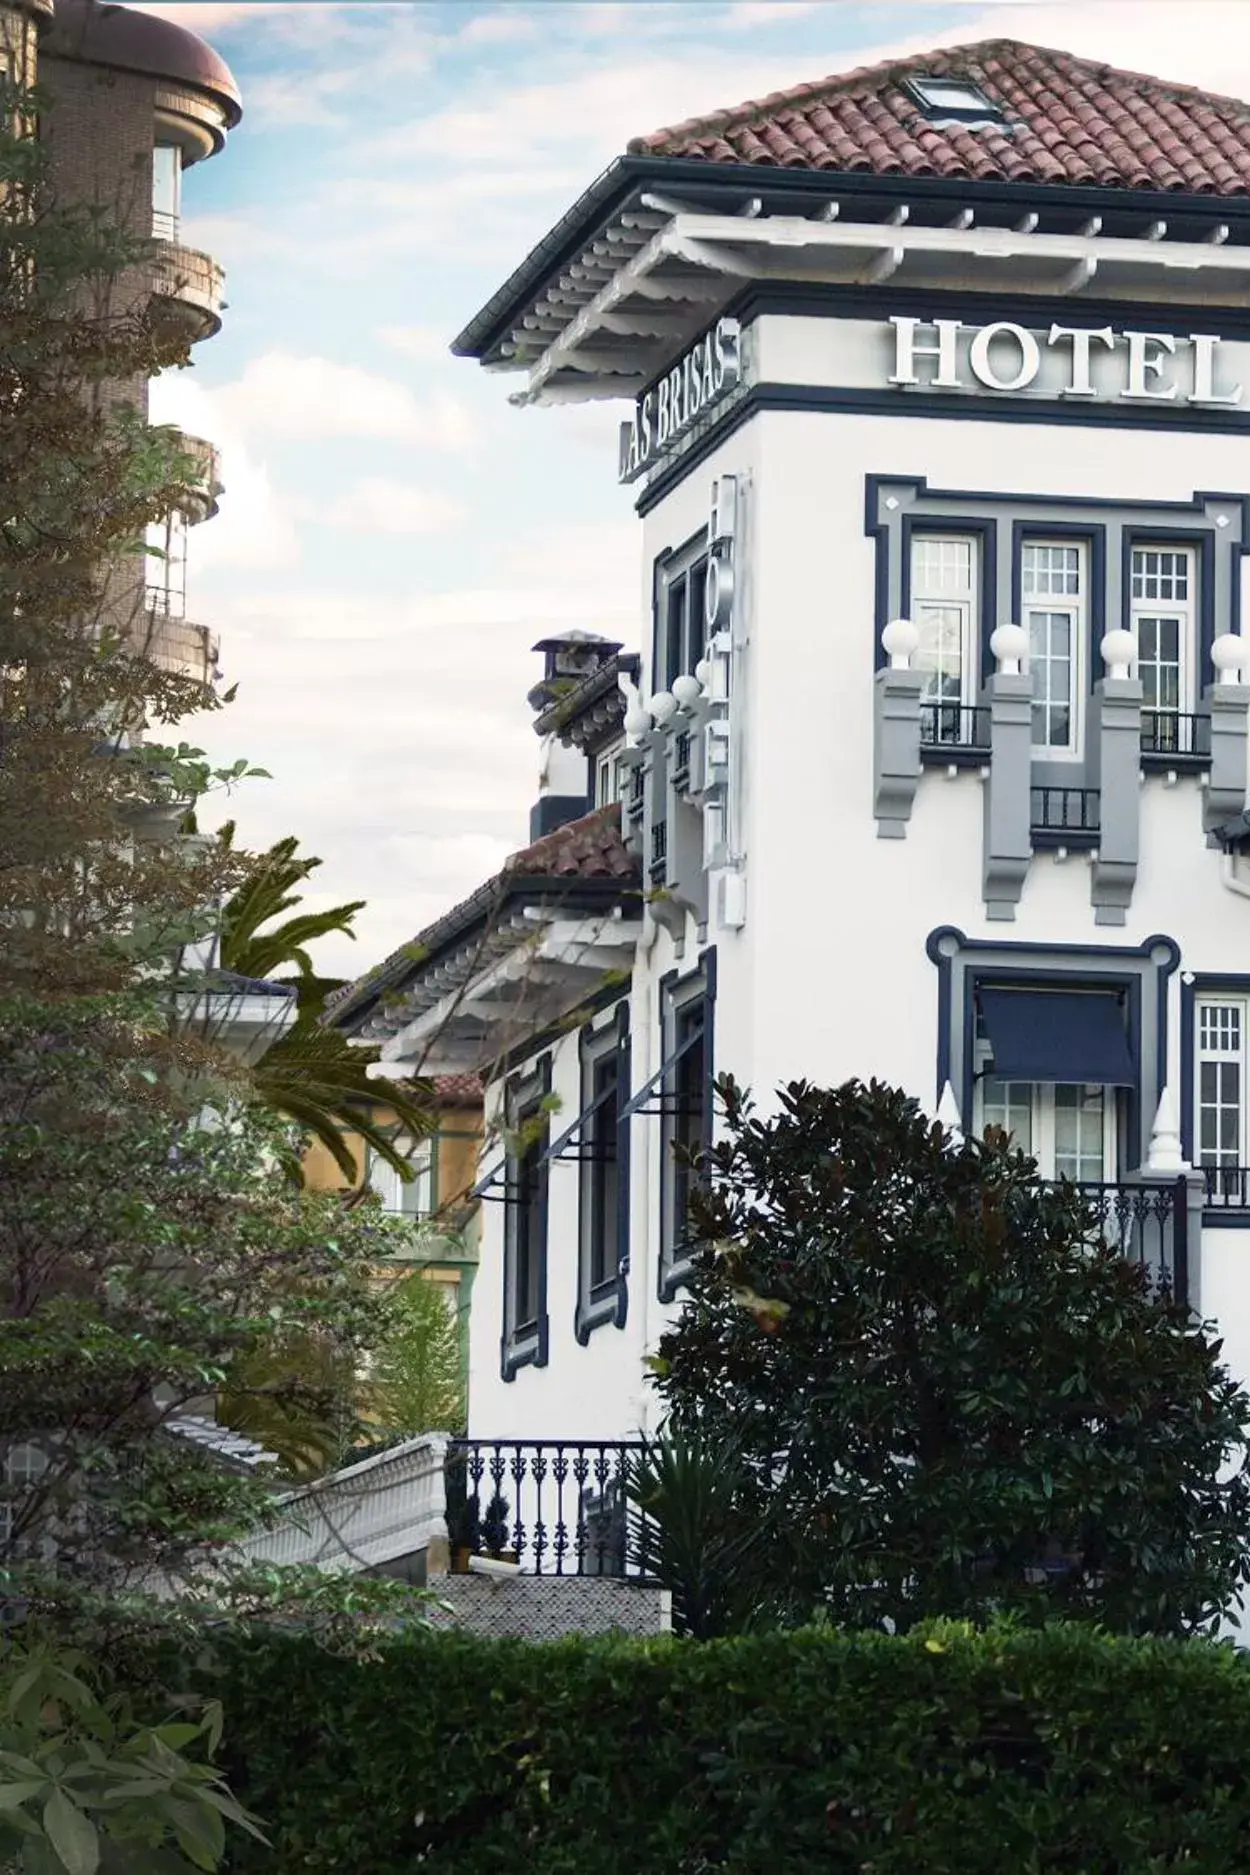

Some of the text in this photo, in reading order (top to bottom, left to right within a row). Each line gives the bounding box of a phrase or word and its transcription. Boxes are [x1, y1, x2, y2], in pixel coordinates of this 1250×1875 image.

[617, 316, 740, 484] LAS BRISAS
[888, 315, 1243, 404] HOTEL
